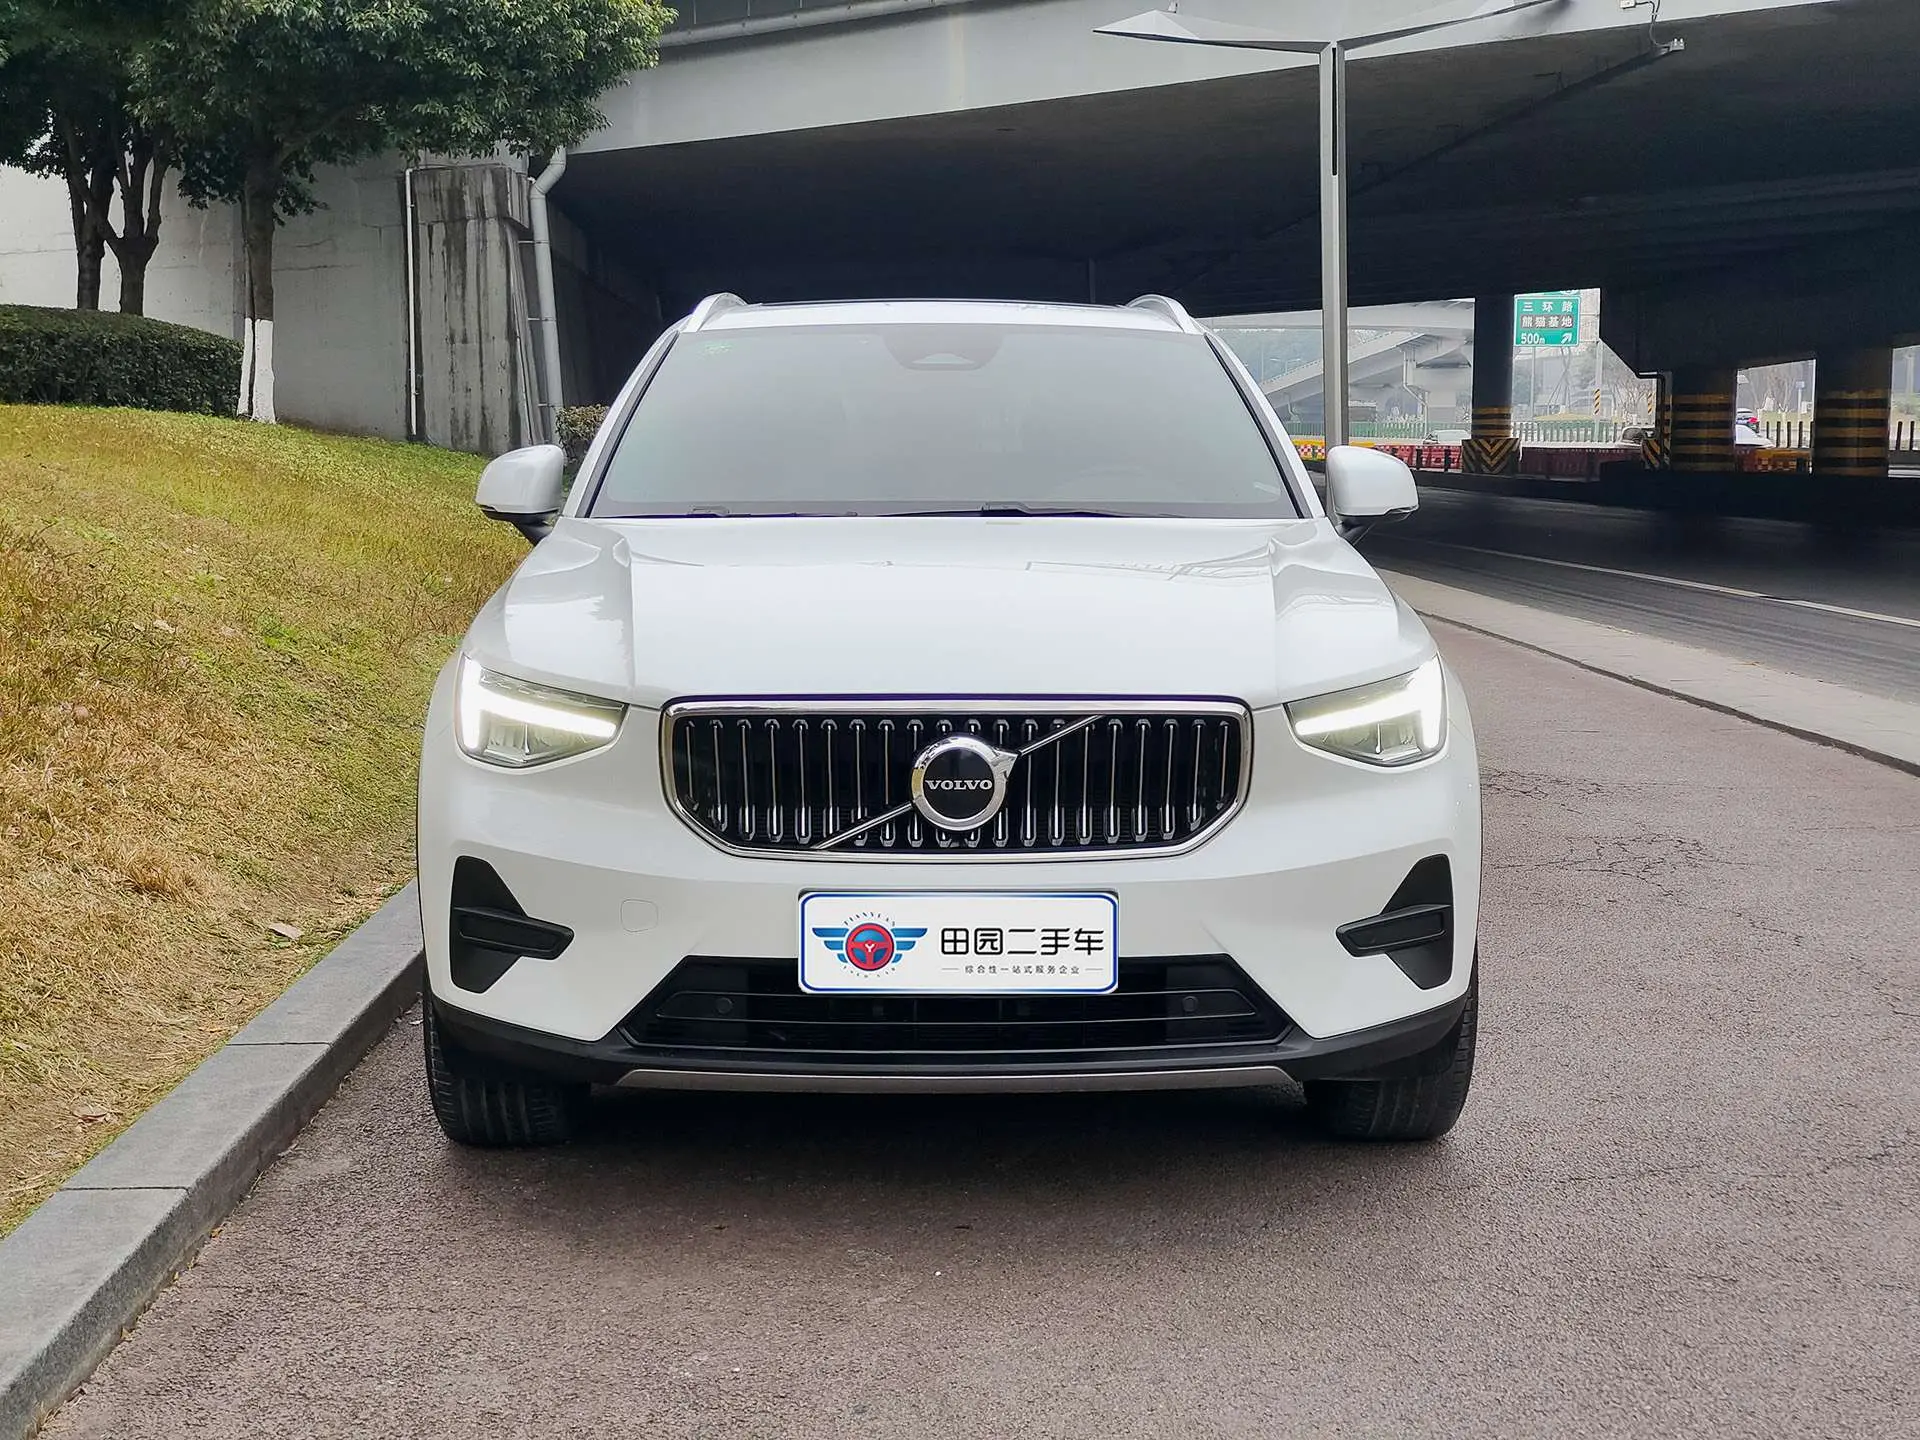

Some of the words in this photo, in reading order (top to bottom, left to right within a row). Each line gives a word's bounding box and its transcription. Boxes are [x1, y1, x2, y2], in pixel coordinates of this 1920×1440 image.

[1522, 301, 1573, 312] 三环路
[1521, 333, 1545, 345] 500m
[925, 780, 993, 790] VOLVO
[941, 928, 1104, 955] 田园二手车
[964, 965, 1080, 975] 综合性一站式服务企业
